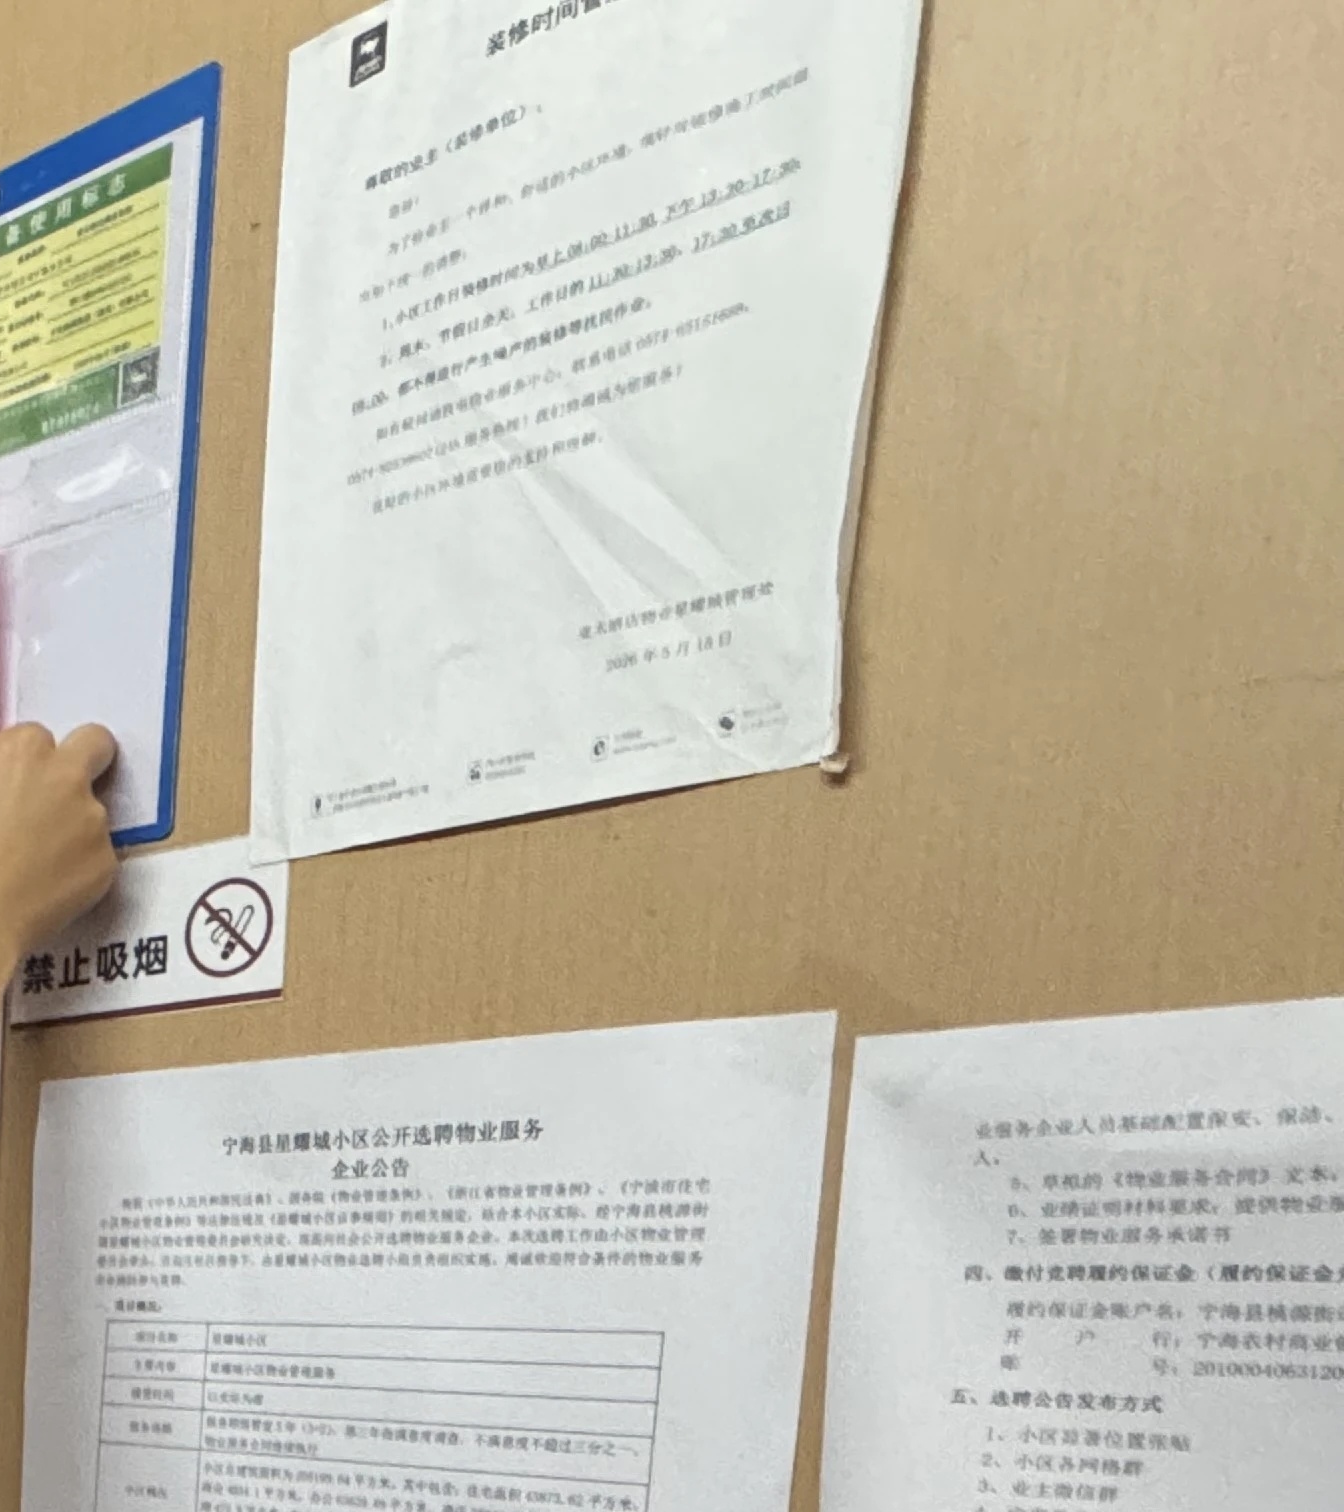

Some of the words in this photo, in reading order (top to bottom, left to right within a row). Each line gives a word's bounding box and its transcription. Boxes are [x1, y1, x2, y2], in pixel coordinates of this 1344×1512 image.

[21, 934, 168, 995] 禁止吸烟
[221, 1118, 545, 1159] 宁海县星耀城小区公开选聘物业服务
[330, 1155, 410, 1180] 企业公告
